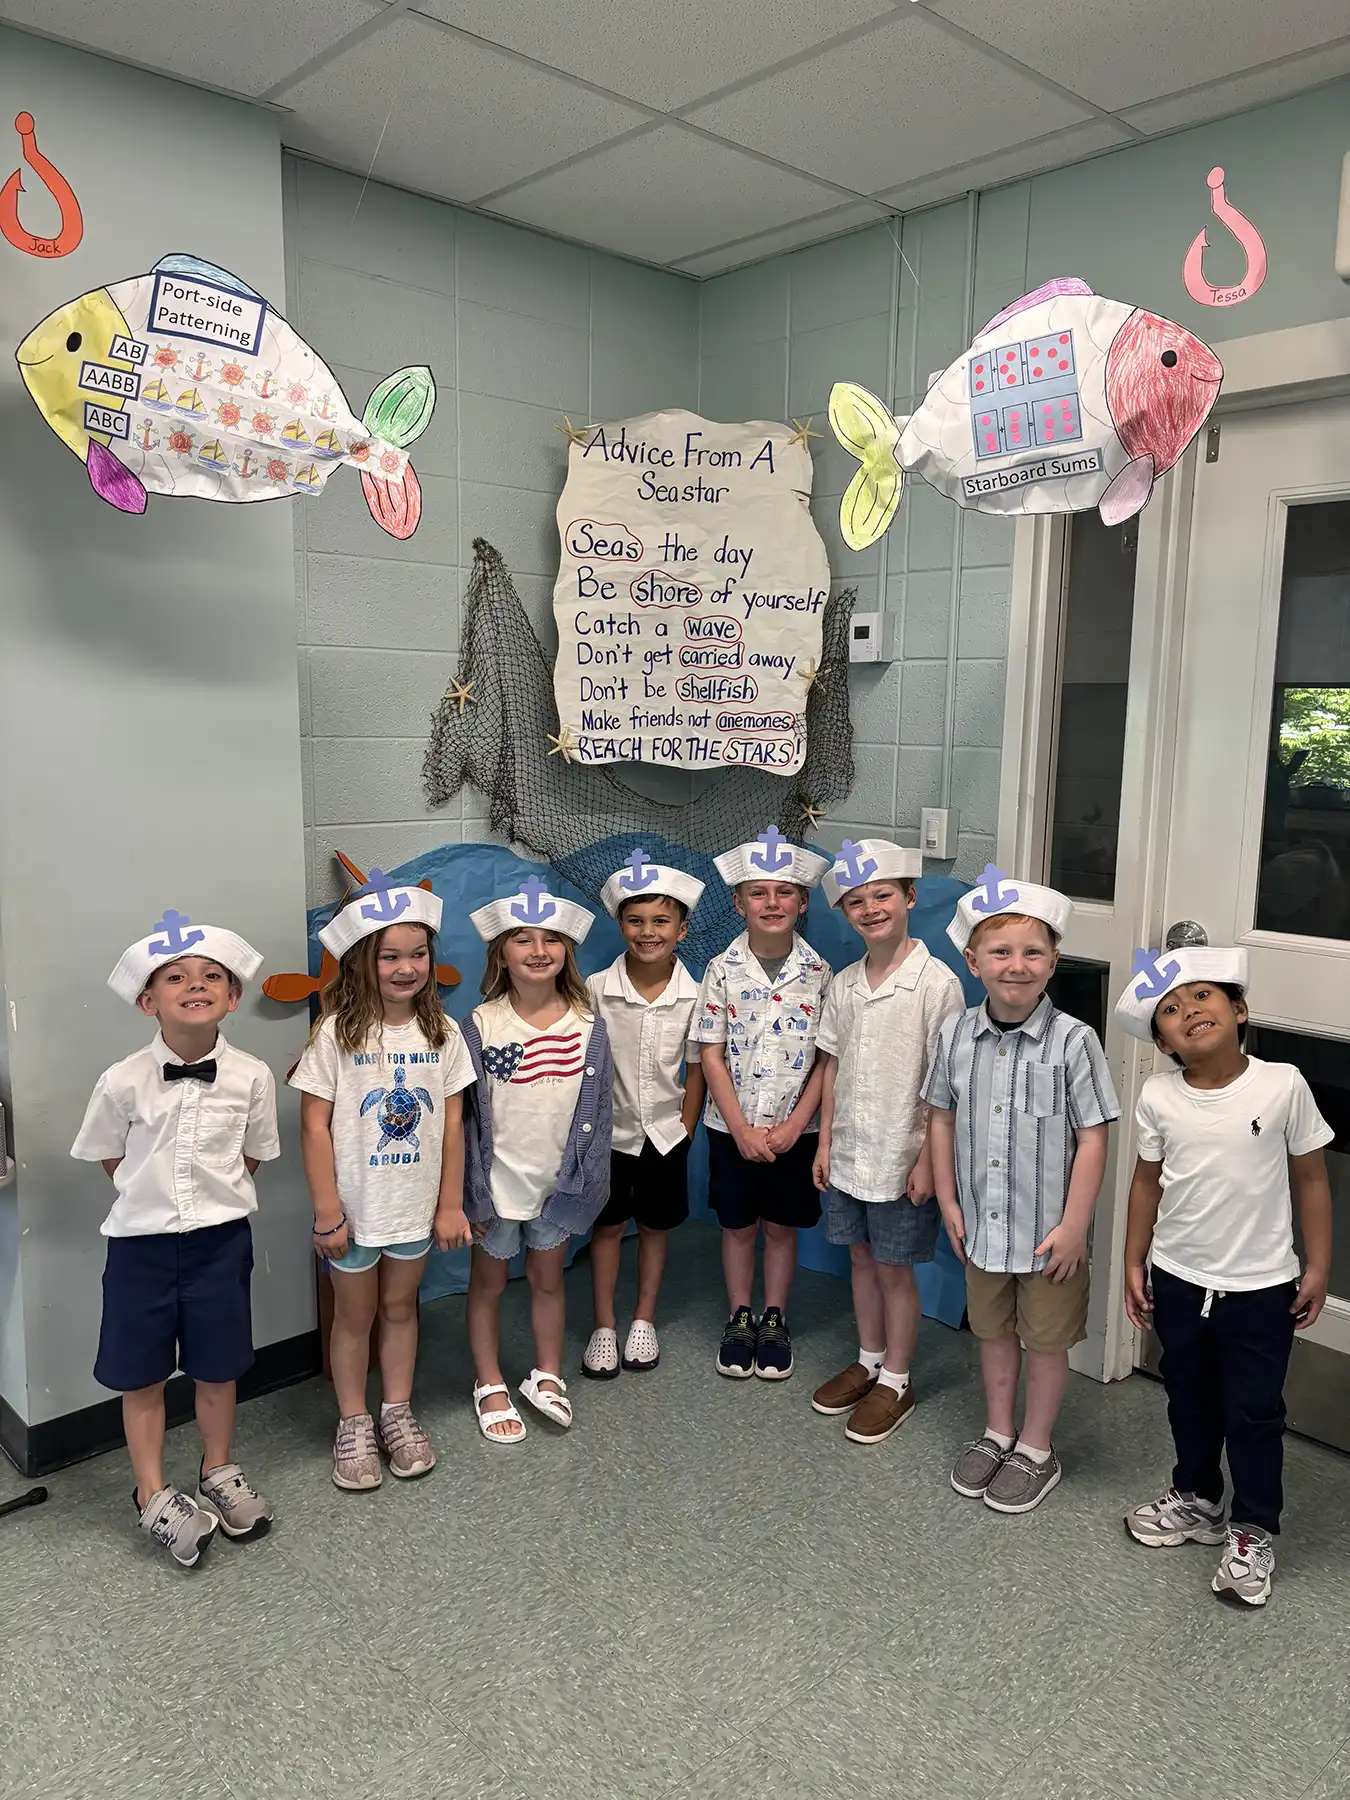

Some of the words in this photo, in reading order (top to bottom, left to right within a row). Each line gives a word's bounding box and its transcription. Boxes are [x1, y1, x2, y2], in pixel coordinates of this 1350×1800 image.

[28, 238, 62, 254] Jack
[162, 282, 243, 317] Port-side
[1210, 287, 1247, 303] Tessa
[157, 307, 251, 347] Patterning
[115, 342, 142, 360] AB
[85, 369, 135, 393] AABB
[89, 413, 125, 432] ABC
[583, 427, 675, 467] Advice
[683, 432, 741, 468] From
[750, 440, 775, 474] A
[637, 471, 729, 503] Seastar
[965, 463, 1047, 495] Starboard
[1050, 455, 1098, 476] Sums
[572, 524, 639, 559] Seas
[658, 533, 698, 562] the
[714, 535, 754, 579] day
[577, 565, 617, 599] Be
[635, 573, 699, 603] shore
[710, 577, 737, 603] of
[743, 587, 827, 620] yourself
[575, 611, 641, 637] Catch
[655, 622, 668, 637] a
[688, 619, 736, 639] wave
[577, 642, 632, 665] Don't
[642, 644, 673, 675] get
[681, 643, 741, 667] carried
[749, 651, 795, 680] away
[580, 676, 628, 702] Don't
[644, 676, 667, 698] be
[681, 680, 754, 701] shellfish
[582, 709, 621, 731] Make
[629, 706, 683, 729] friends
[688, 709, 711, 728] not
[718, 714, 792, 729] anemones
[578, 736, 642, 760] REACH
[652, 737, 682, 760] FOR
[686, 738, 722, 761] THE
[387, 1053, 406, 1064] FOR
[409, 1052, 440, 1064] WAVES
[369, 1152, 420, 1166] ARUBA
